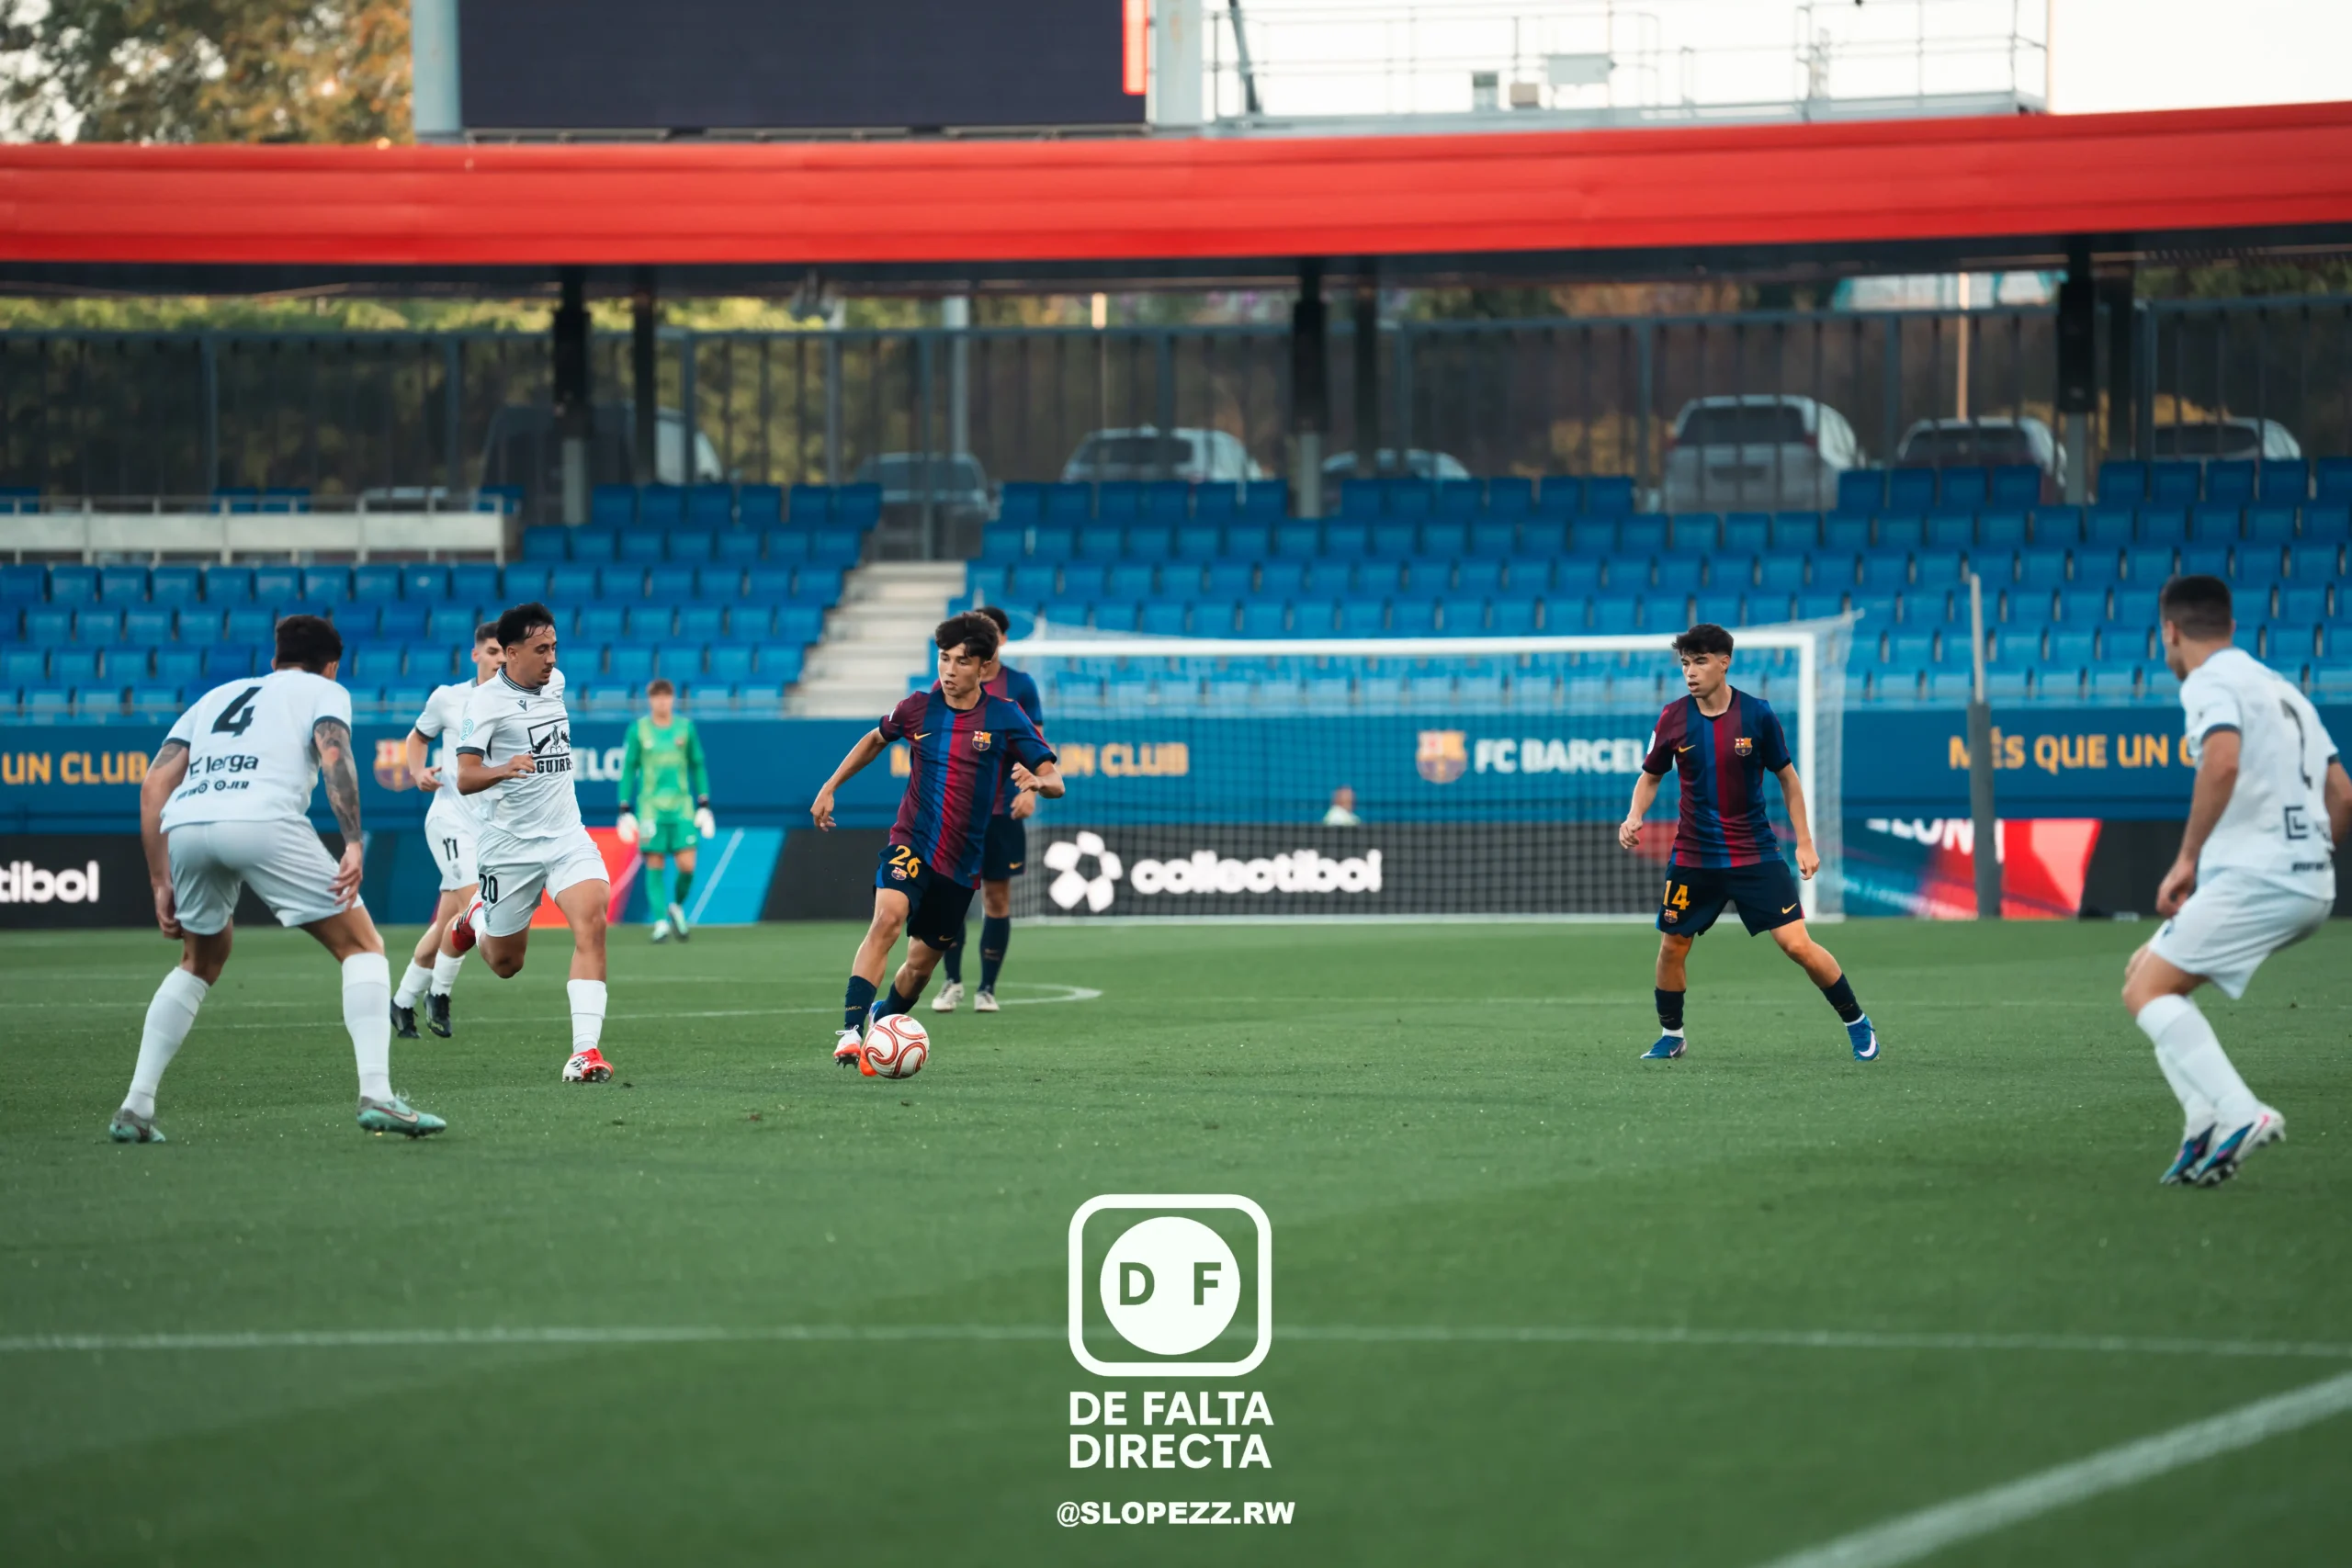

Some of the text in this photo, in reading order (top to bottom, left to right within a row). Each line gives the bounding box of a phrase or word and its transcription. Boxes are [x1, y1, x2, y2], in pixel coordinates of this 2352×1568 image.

[210, 686, 263, 738] 4
[2, 750, 151, 785] UN CLUB
[526, 756, 573, 774] GUIRR
[1474, 738, 1645, 774] FC BARCEL
[2034, 734, 2108, 775] QUE
[2117, 734, 2169, 768] UN
[443, 837, 458, 862] 11
[888, 844, 922, 879] 26
[479, 873, 499, 905] 20
[1663, 880, 1690, 910] 14
